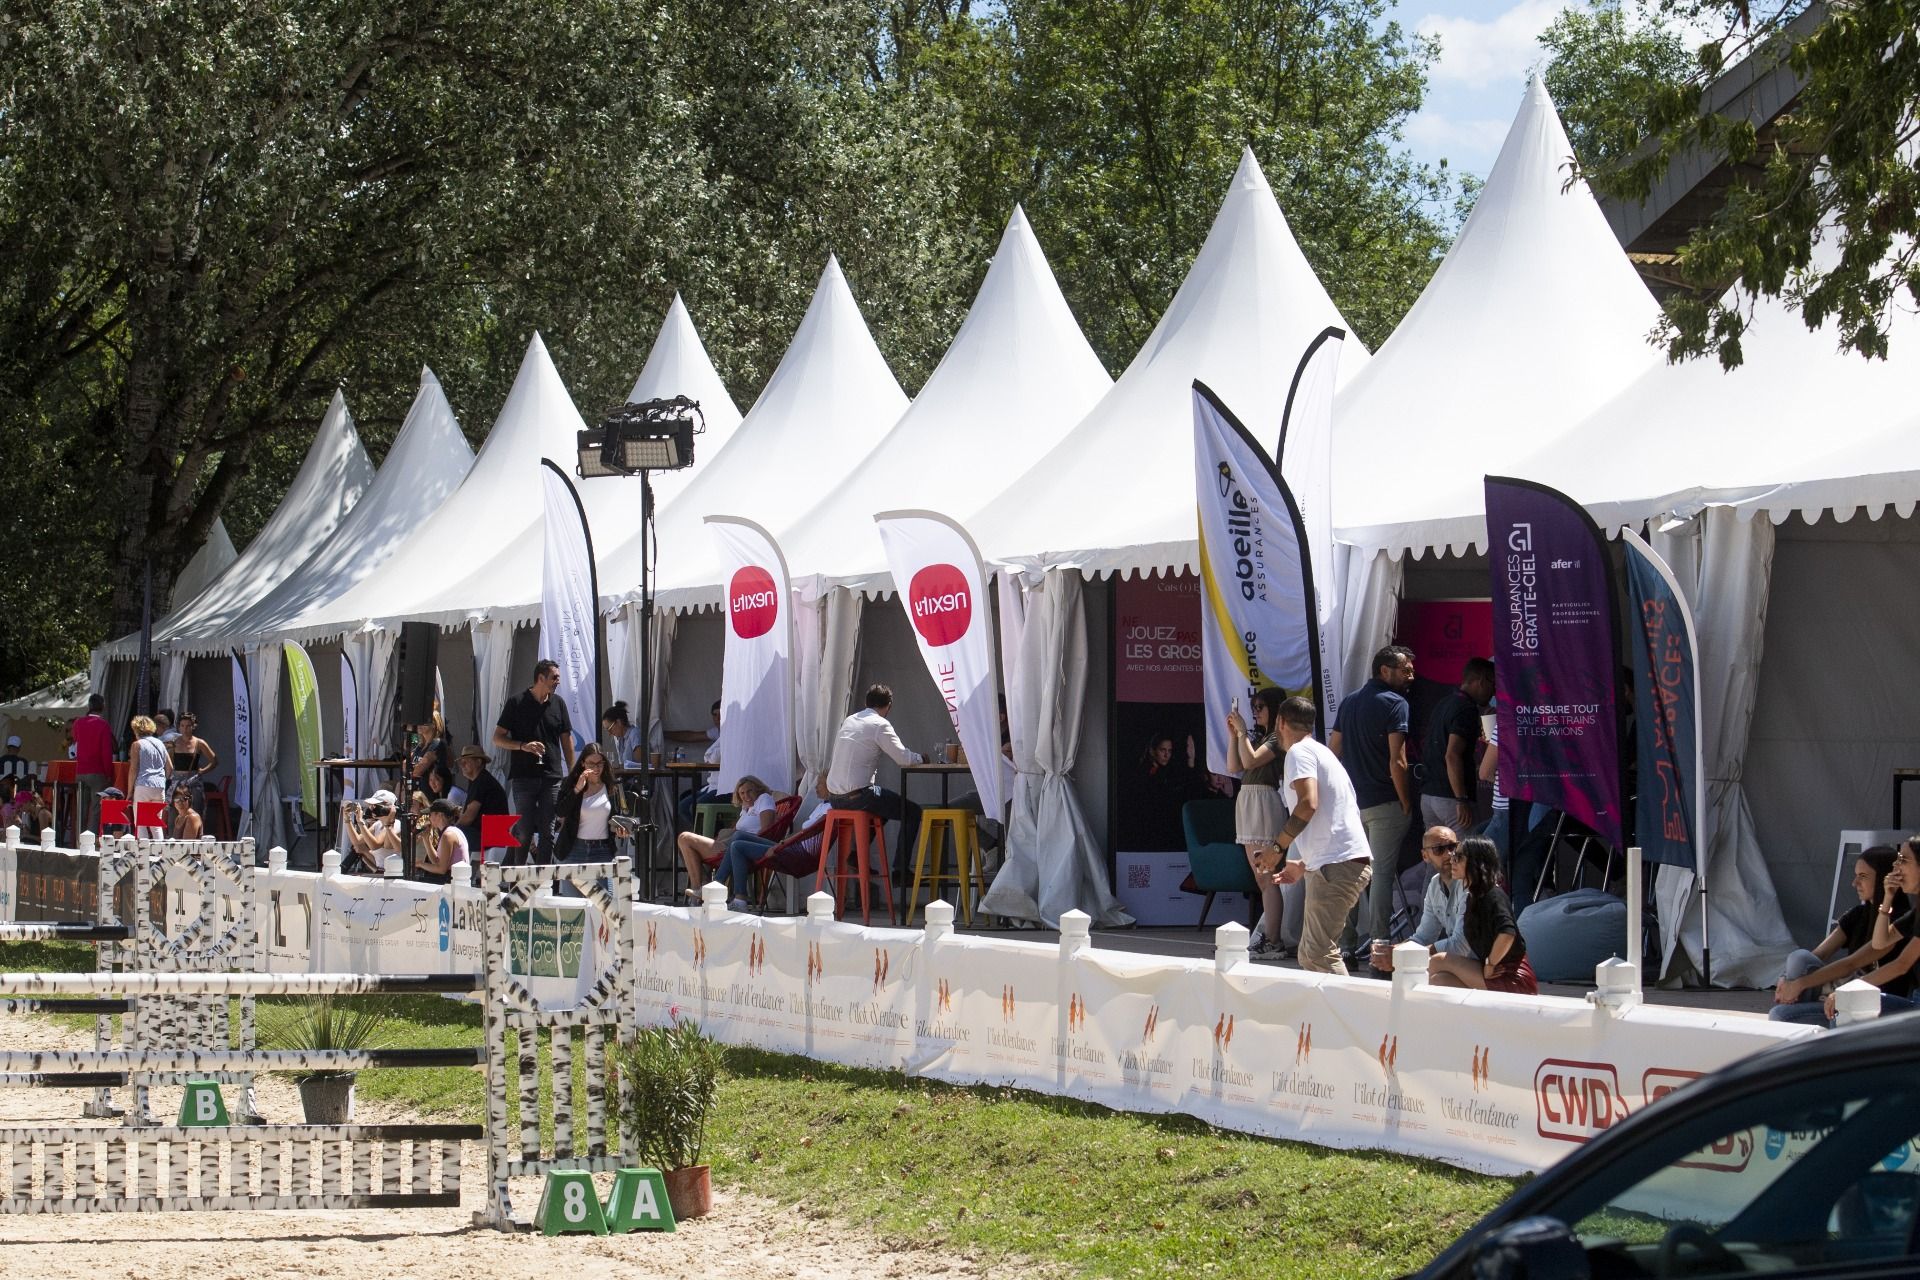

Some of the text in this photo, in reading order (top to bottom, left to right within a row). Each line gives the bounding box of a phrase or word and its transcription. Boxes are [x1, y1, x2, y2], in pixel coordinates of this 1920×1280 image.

[1232, 489, 1256, 602] abeille
[1250, 496, 1268, 602] ASSURANCES
[1550, 559, 1573, 569] afer
[1507, 554, 1525, 650] ASSURANCES
[1522, 553, 1539, 649] GRATTE-CIEL
[1126, 626, 1177, 640] JOUEZ
[1126, 644, 1202, 659] LES GROS
[1126, 664, 1145, 672] AVEC
[1146, 664, 1161, 672] NOS
[1162, 664, 1194, 672] AGENTES
[1244, 631, 1261, 699] France
[1516, 704, 1600, 714] ON ASSURE TOUT
[1516, 715, 1596, 726] SAUF LES TRAINS
[1517, 727, 1584, 736] ET LES AVIONS
[195, 1089, 218, 1121] B
[1541, 1073, 1613, 1130] CWD
[562, 1181, 587, 1223] 8
[631, 1179, 661, 1219] A
